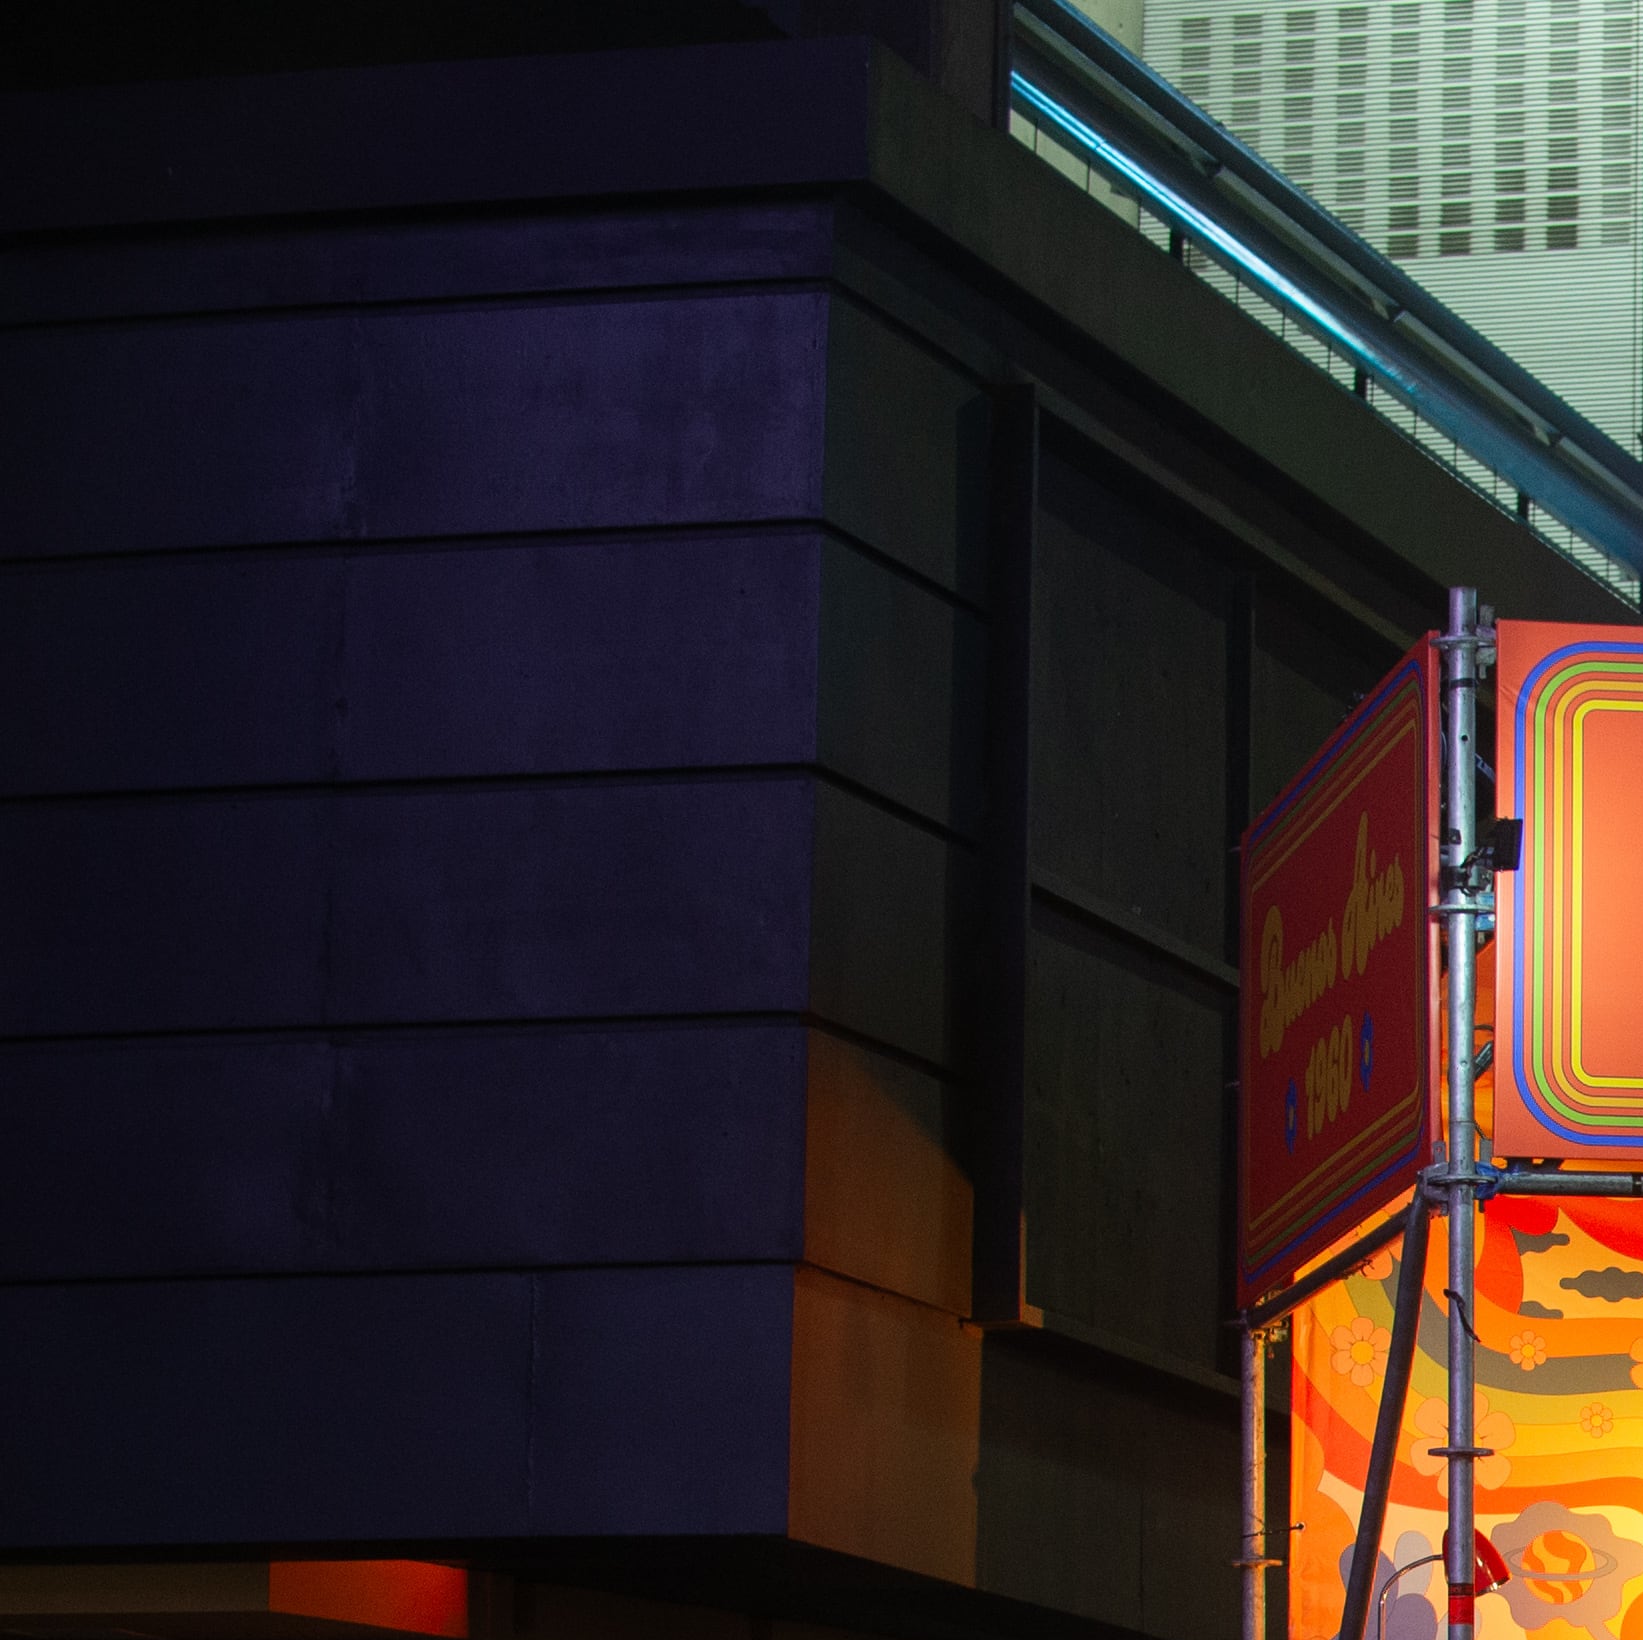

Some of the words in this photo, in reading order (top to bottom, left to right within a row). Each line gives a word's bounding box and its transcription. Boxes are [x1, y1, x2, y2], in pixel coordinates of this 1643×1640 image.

[1260, 904, 1337, 1060] Buenos
[1339, 809, 1404, 978] Aires
[1304, 1013, 1354, 1142] 1960
